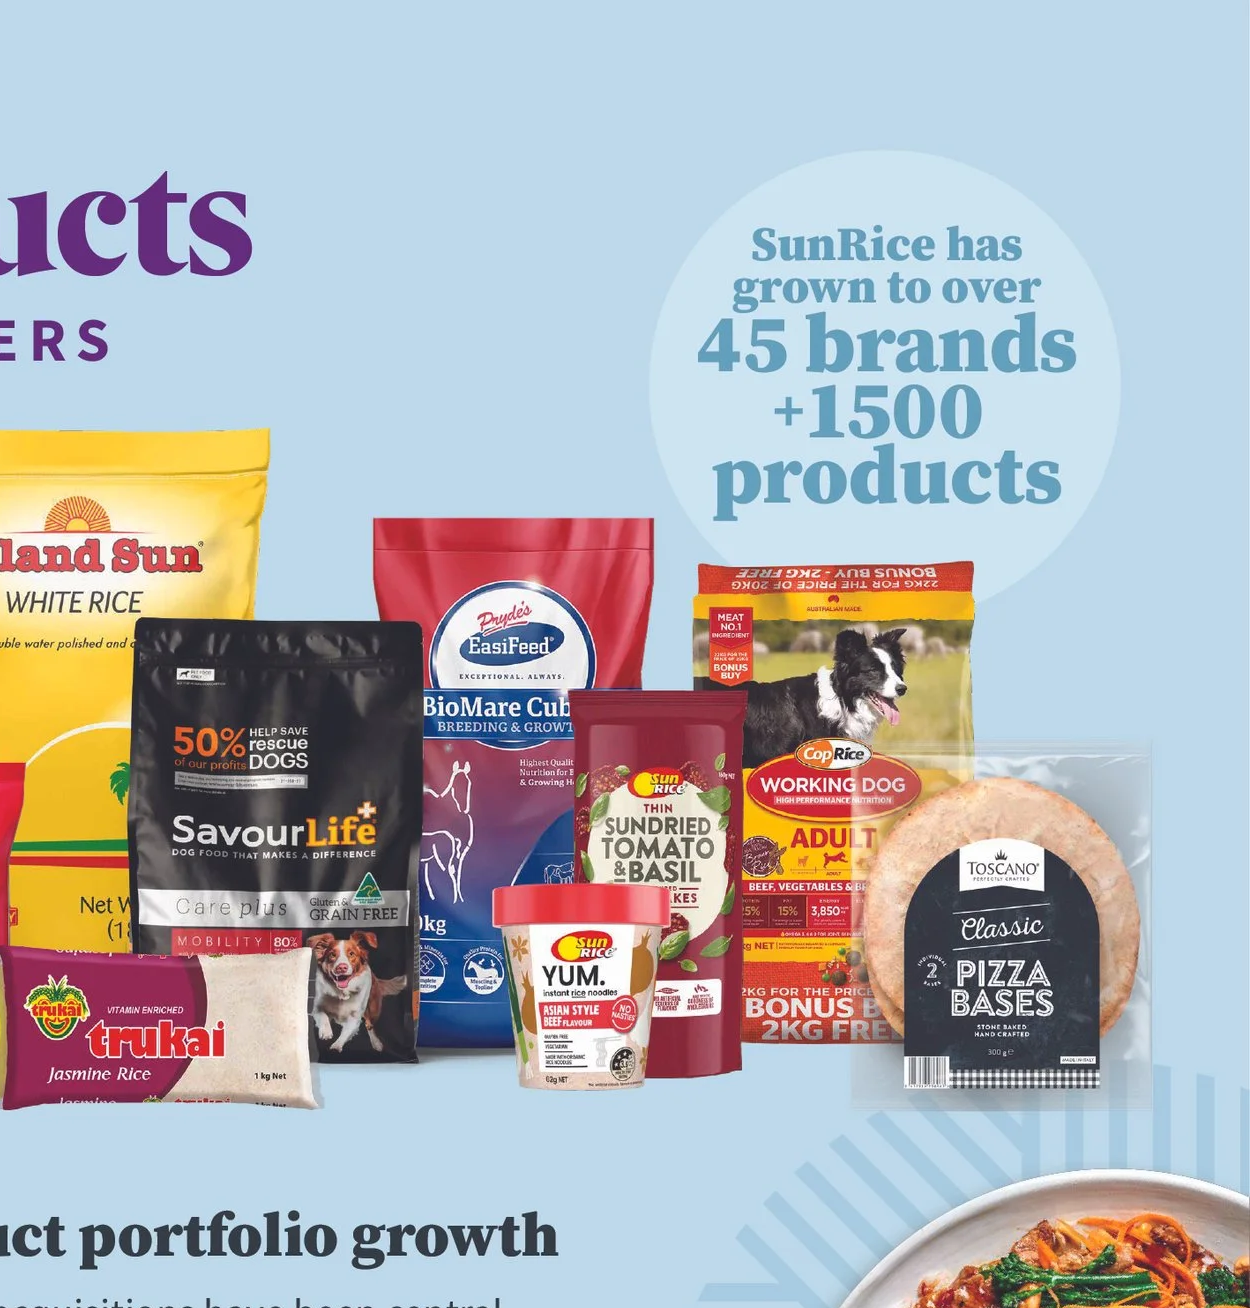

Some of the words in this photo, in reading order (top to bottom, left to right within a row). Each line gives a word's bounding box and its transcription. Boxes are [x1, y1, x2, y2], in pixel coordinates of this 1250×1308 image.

[752, 225, 935, 261] SunRice
[947, 226, 1022, 261] has
[733, 278, 876, 313] grown
[887, 272, 931, 303] to
[942, 278, 1041, 303] over
[698, 318, 787, 373] 45
[806, 312, 1076, 373] brands
[775, 384, 982, 439] +1500
[712, 443, 1061, 521] products
[112, 538, 203, 573] Sun
[6, 591, 83, 613] WHITE
[89, 591, 143, 613] RICE
[25, 639, 54, 649] water
[57, 637, 102, 650] polished
[106, 637, 127, 649] and
[469, 637, 550, 654] EasiFeed
[424, 697, 521, 717] BioMare
[250, 728, 277, 736] HELP
[280, 727, 308, 736] SAVE
[438, 722, 507, 732] BREEDING
[174, 727, 246, 757] 50%
[250, 737, 308, 751] rescue
[250, 754, 308, 769] DOGS
[804, 747, 864, 762] CopRice
[760, 778, 855, 793] WORKING
[862, 778, 906, 793] DOG
[644, 804, 672, 813] THIN
[605, 817, 711, 836] SUNDRIED
[602, 837, 714, 859] TOMATO
[790, 828, 877, 849] ADULT
[172, 849, 195, 857] DOG
[199, 849, 228, 857] FOOD
[313, 850, 376, 859] DIFFERENCE
[966, 862, 1037, 875] TOSCANO
[310, 908, 358, 921] GRAIN
[363, 908, 398, 920] FREE
[961, 917, 1044, 940] Classic
[542, 965, 605, 986] YUM.
[957, 960, 1051, 987] PIZZA
[544, 1005, 570, 1015] ASIAN
[573, 1005, 599, 1015] STYLE
[746, 998, 854, 1018] BONUS
[951, 989, 1054, 1017] BASES
[85, 1019, 225, 1059] trukai
[47, 1067, 111, 1084] Jasmine
[117, 1067, 151, 1082] Rice
[79, 1210, 337, 1270] portfolio
[352, 1211, 558, 1270] growth
